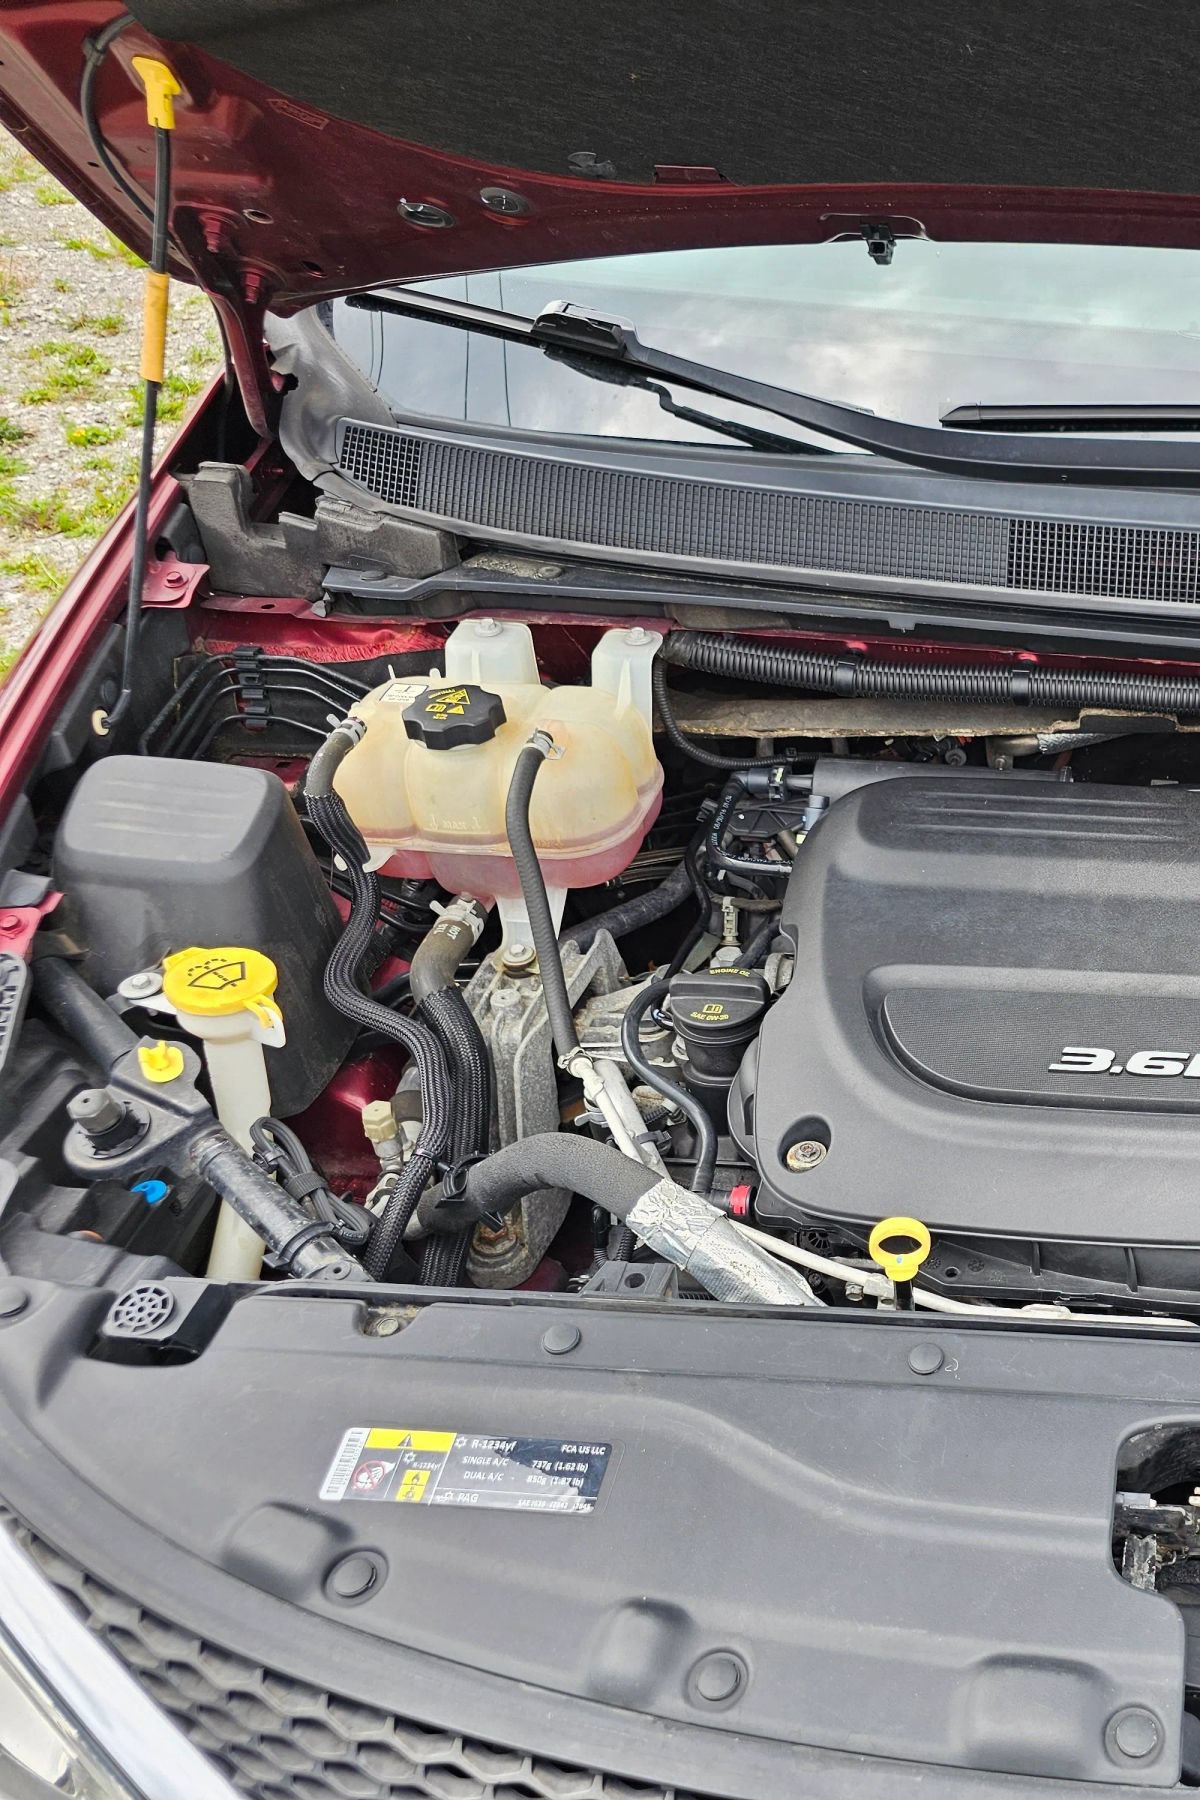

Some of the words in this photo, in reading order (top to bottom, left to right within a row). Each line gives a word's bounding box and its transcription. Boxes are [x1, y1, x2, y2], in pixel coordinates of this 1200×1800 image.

[739, 970, 751, 978] OIL
[690, 1011, 706, 1020] SAE
[471, 1439, 518, 1452] R-1234yf
[561, 1444, 577, 1454] FCA
[578, 1446, 590, 1454] US
[591, 1446, 606, 1455] LLC
[462, 1455, 492, 1465] SINGLE
[492, 1457, 510, 1467] A/C
[532, 1460, 552, 1471] 737g
[554, 1461, 576, 1472] (1.62
[577, 1462, 588, 1473] lb)
[463, 1471, 487, 1480] DUAL
[487, 1472, 505, 1481] A/C
[572, 1477, 584, 1489] lb)
[457, 1492, 480, 1503] PAG
